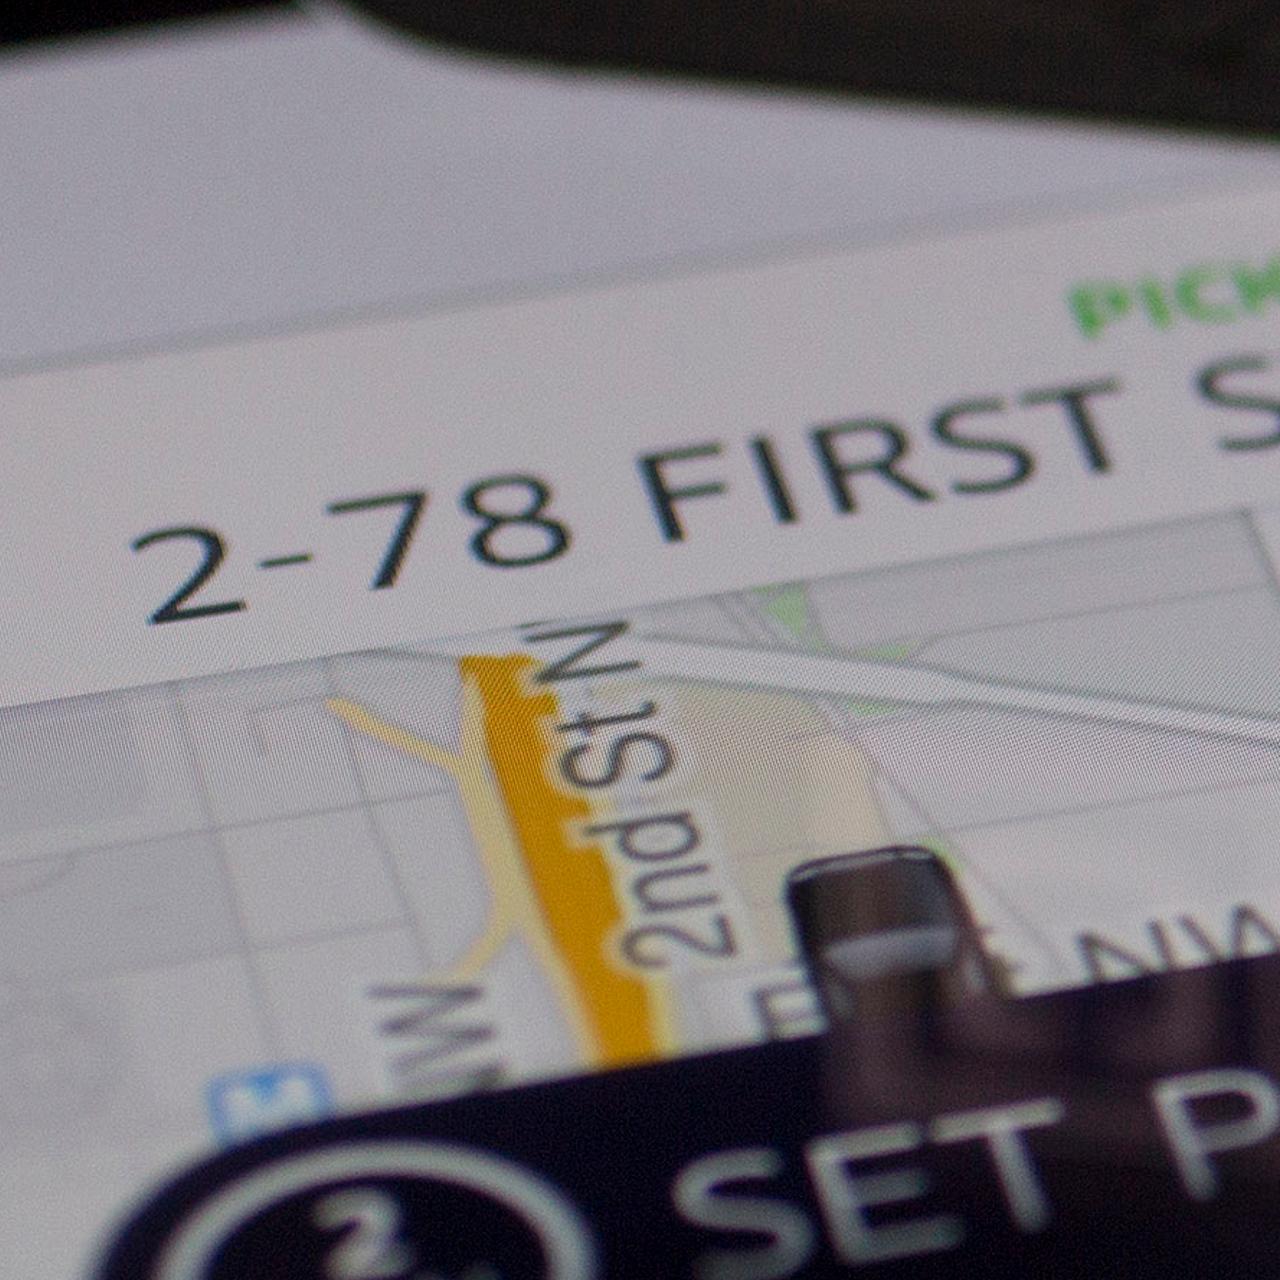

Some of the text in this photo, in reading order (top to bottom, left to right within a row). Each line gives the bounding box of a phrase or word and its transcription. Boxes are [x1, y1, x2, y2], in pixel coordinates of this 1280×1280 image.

[130, 470, 574, 626] 2-78
[635, 378, 1122, 542] FIRST
[555, 699, 677, 791] St
[582, 810, 739, 971] 2nd
